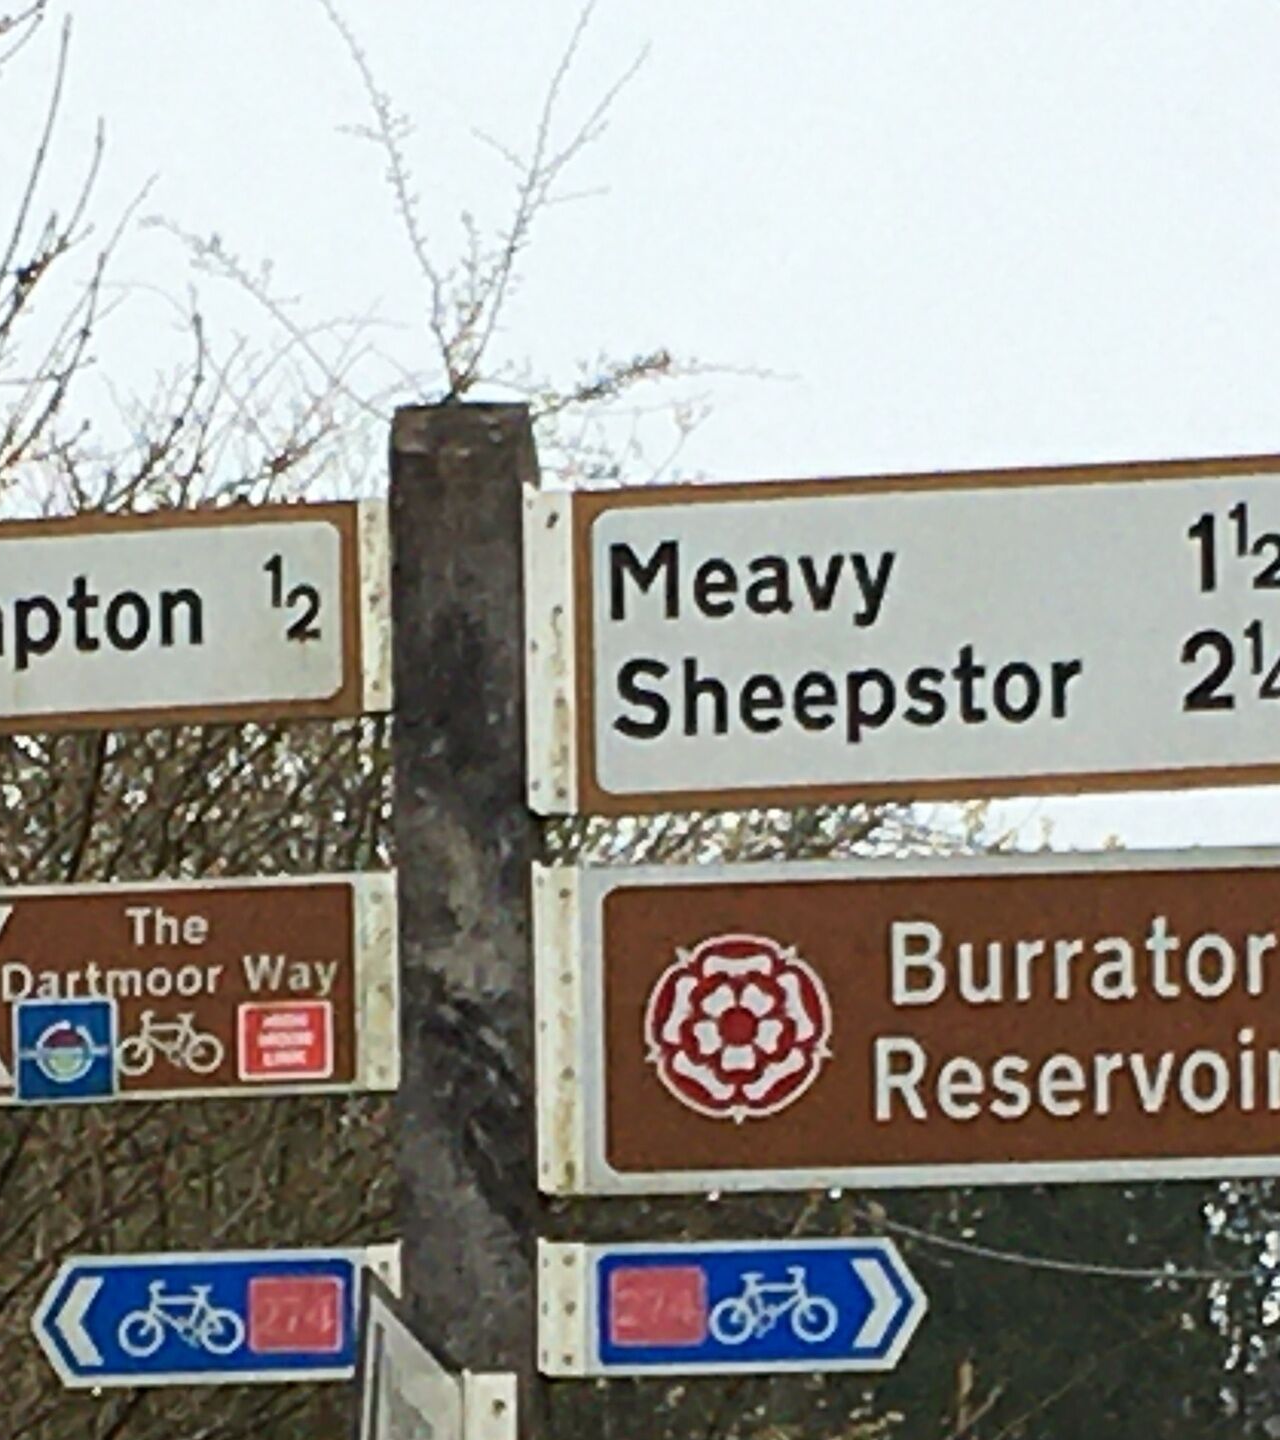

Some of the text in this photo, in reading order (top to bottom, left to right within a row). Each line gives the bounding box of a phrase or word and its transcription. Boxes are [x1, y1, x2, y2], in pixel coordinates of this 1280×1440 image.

[609, 540, 896, 628] Meavy
[613, 644, 1083, 744] Sheepstor
[125, 906, 209, 946] The
[892, 915, 1278, 1005] Burrator
[1, 953, 338, 1001] Dartmoor Way
